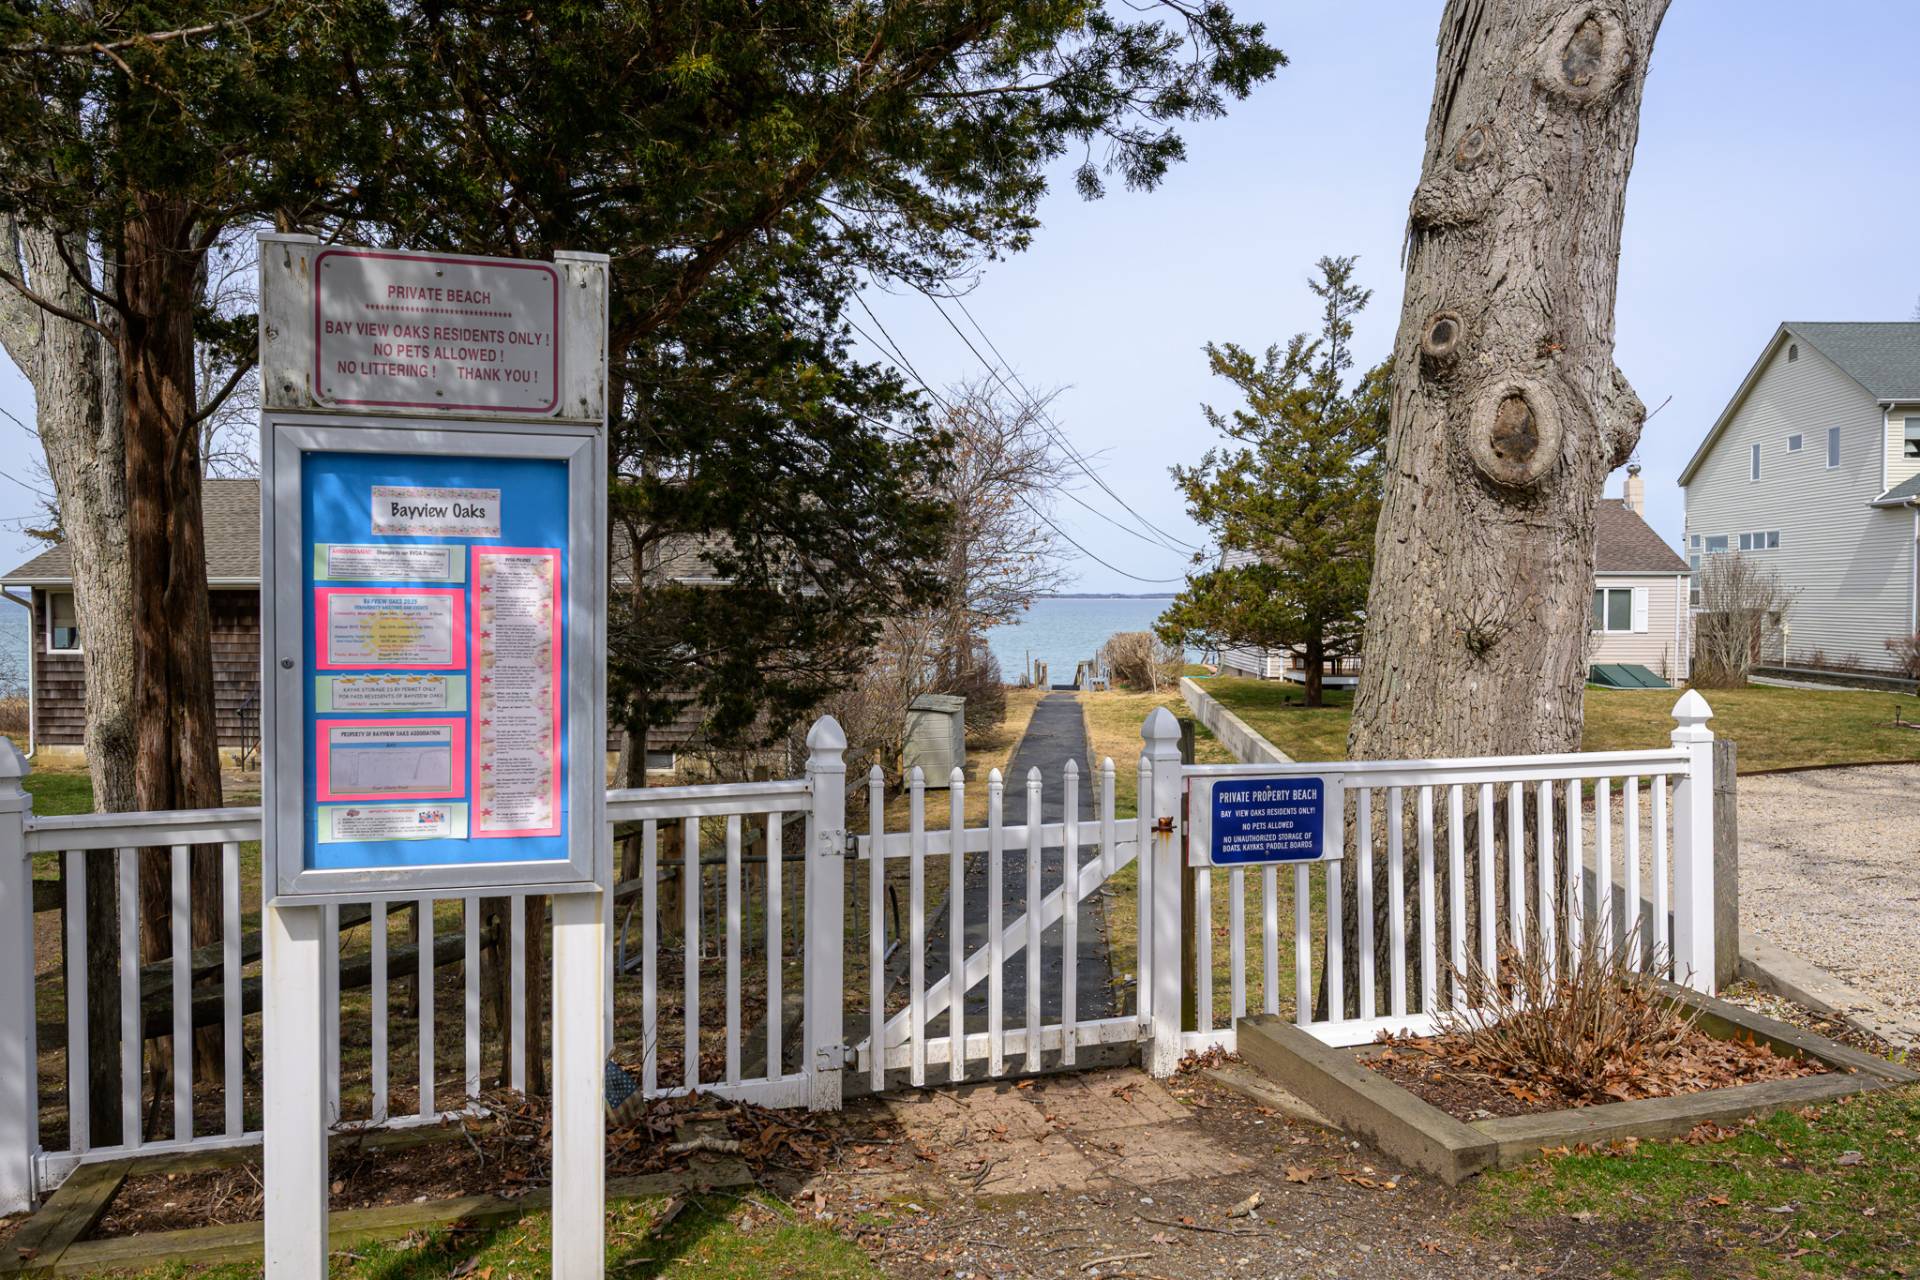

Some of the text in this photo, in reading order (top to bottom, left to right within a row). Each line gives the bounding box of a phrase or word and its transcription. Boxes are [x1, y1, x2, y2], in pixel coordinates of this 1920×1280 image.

[388, 285, 491, 305] PRIVATE BEACH
[325, 320, 352, 336] BAY
[357, 322, 389, 337] VIEW
[393, 324, 430, 340] OAKS
[434, 327, 505, 344] RESIDENTS
[374, 343, 393, 357] NO
[397, 344, 430, 359] PETS
[337, 361, 357, 375] NO
[457, 366, 500, 382] THANK
[391, 502, 486, 520] Bayview Oaks
[1219, 789, 1318, 804] PRIVATE PROPERTY BEACH
[1220, 810, 1232, 818] BAY
[1235, 810, 1249, 818] VIEW
[1267, 808, 1297, 816] RESIDENTS
[1252, 822, 1266, 830] PETS
[1268, 821, 1294, 829] ALLOWED
[1233, 834, 1276, 843] UNAUTHORIZED
[1278, 833, 1303, 841] STORAGE
